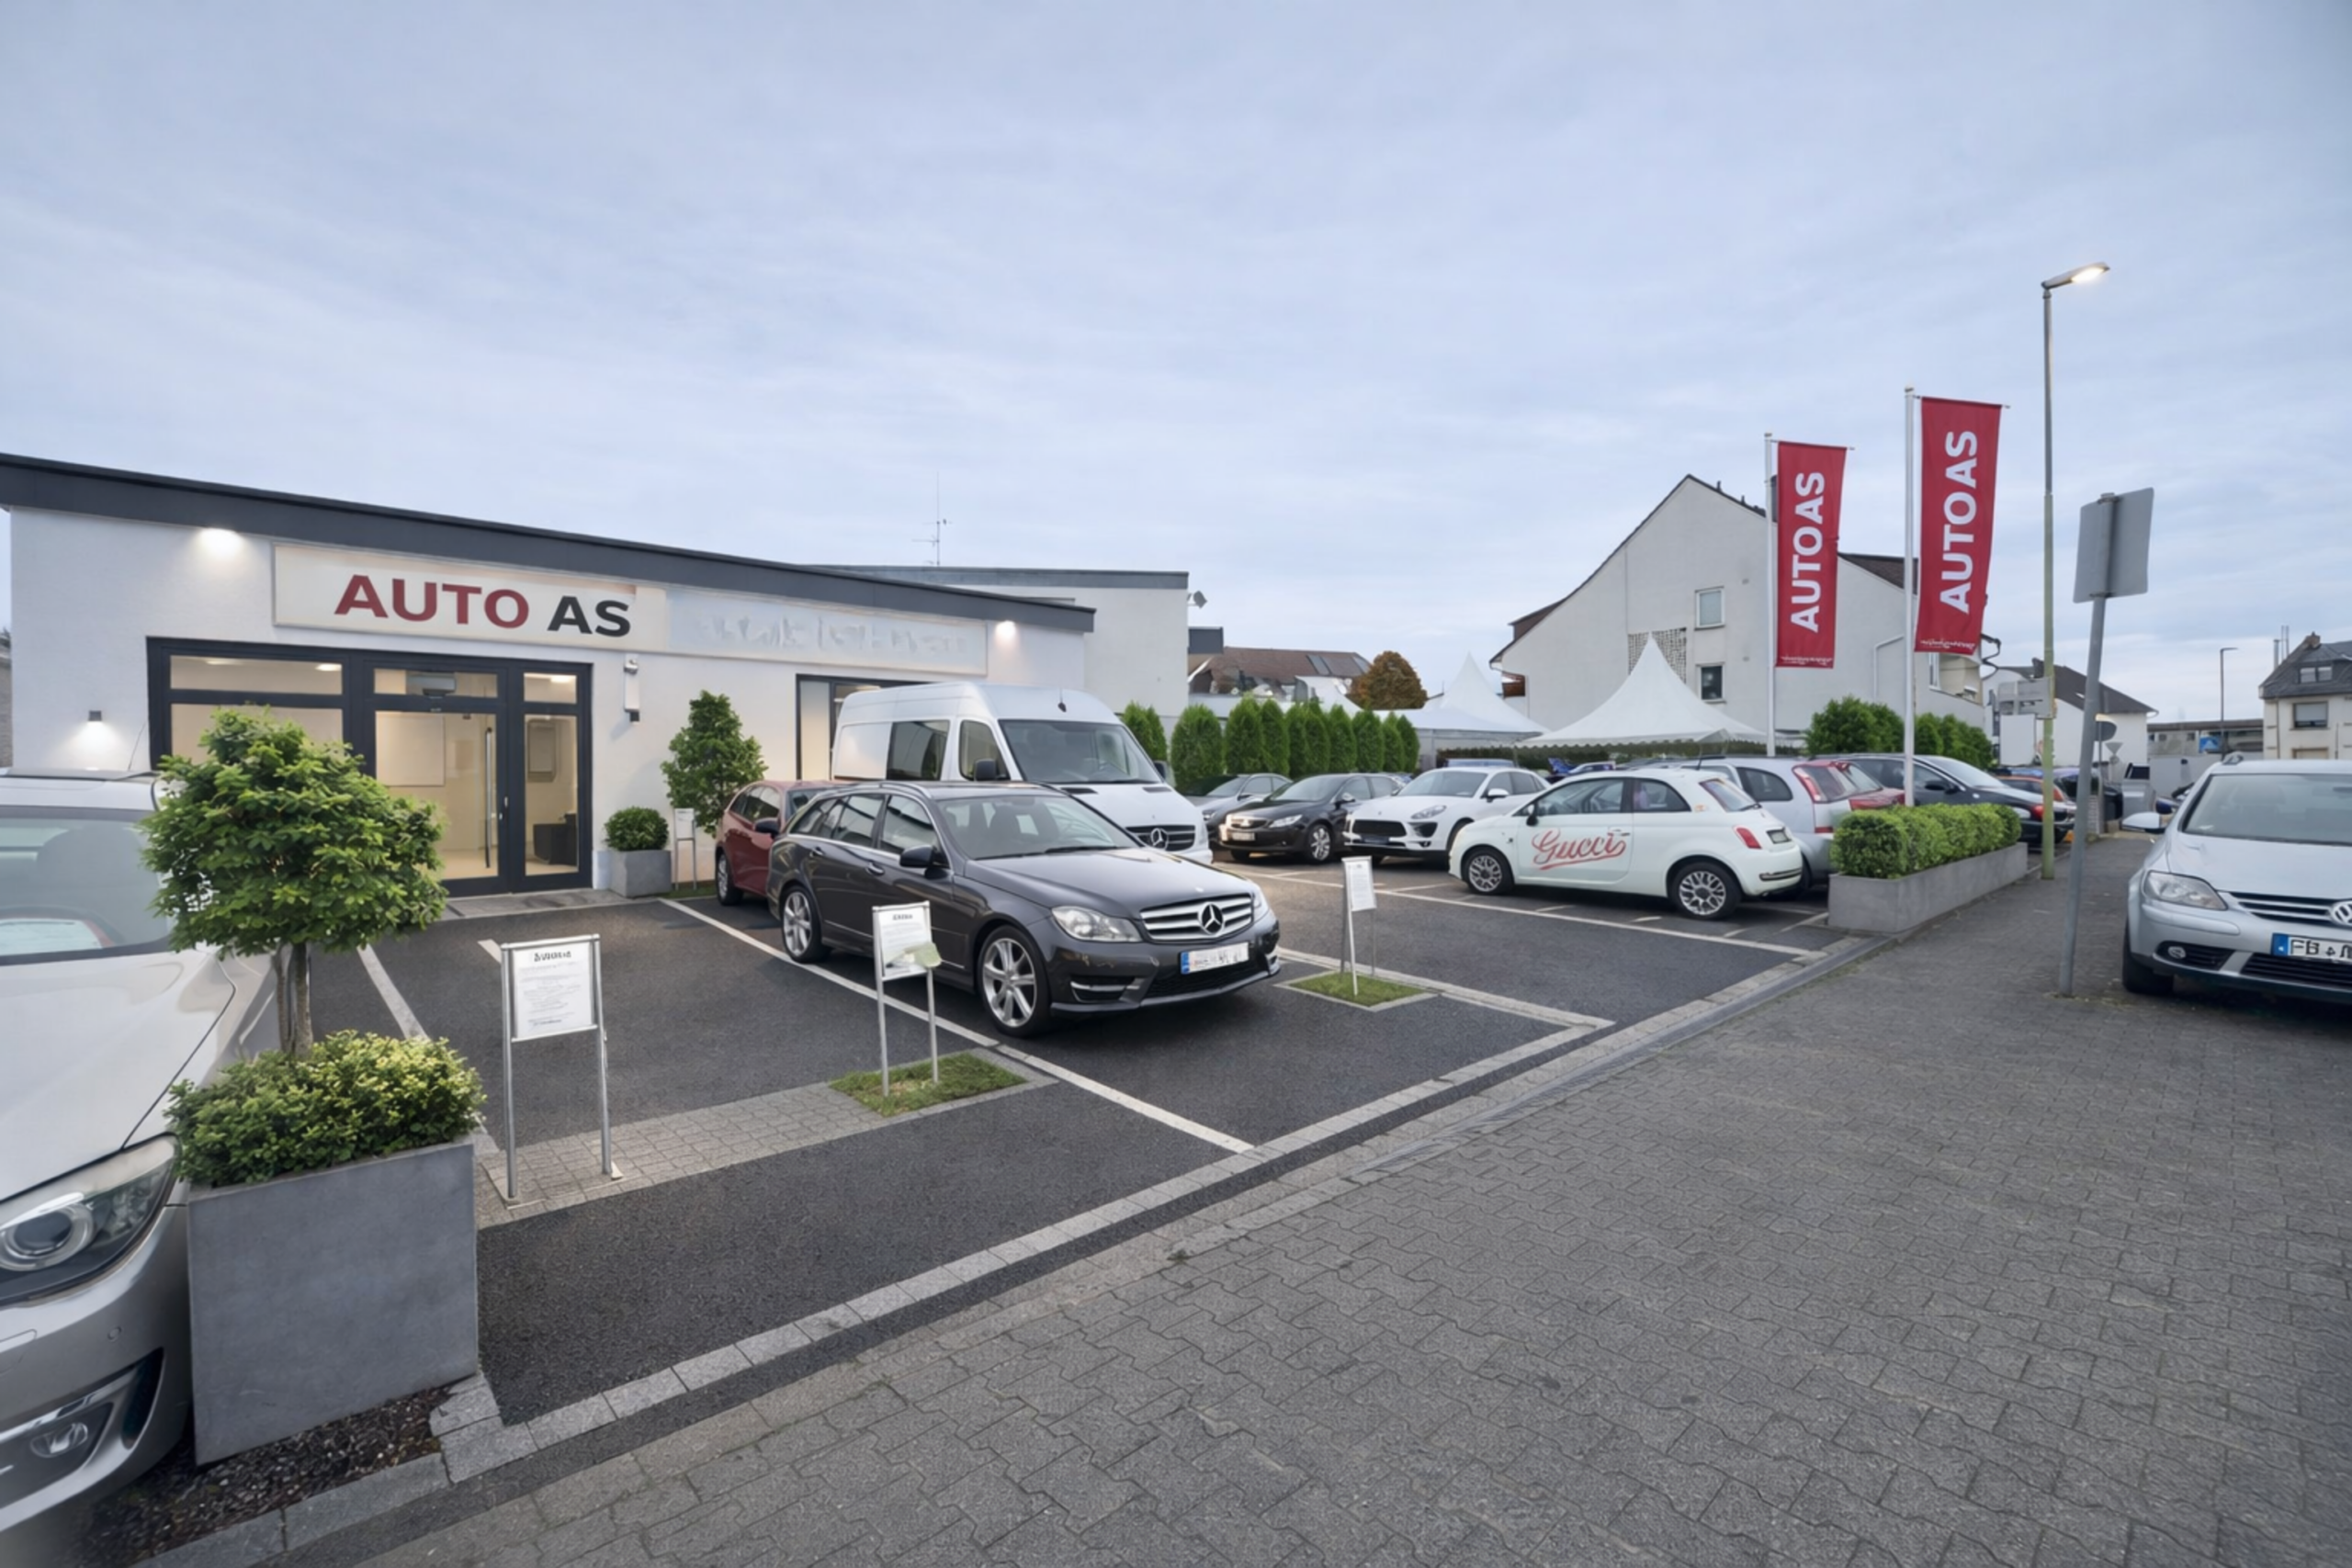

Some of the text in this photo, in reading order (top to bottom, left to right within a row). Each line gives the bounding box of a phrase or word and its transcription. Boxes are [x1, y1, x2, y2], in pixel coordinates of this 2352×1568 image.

[334, 573, 632, 637] AUTO AS
[1532, 828, 1627, 871] Gucci
